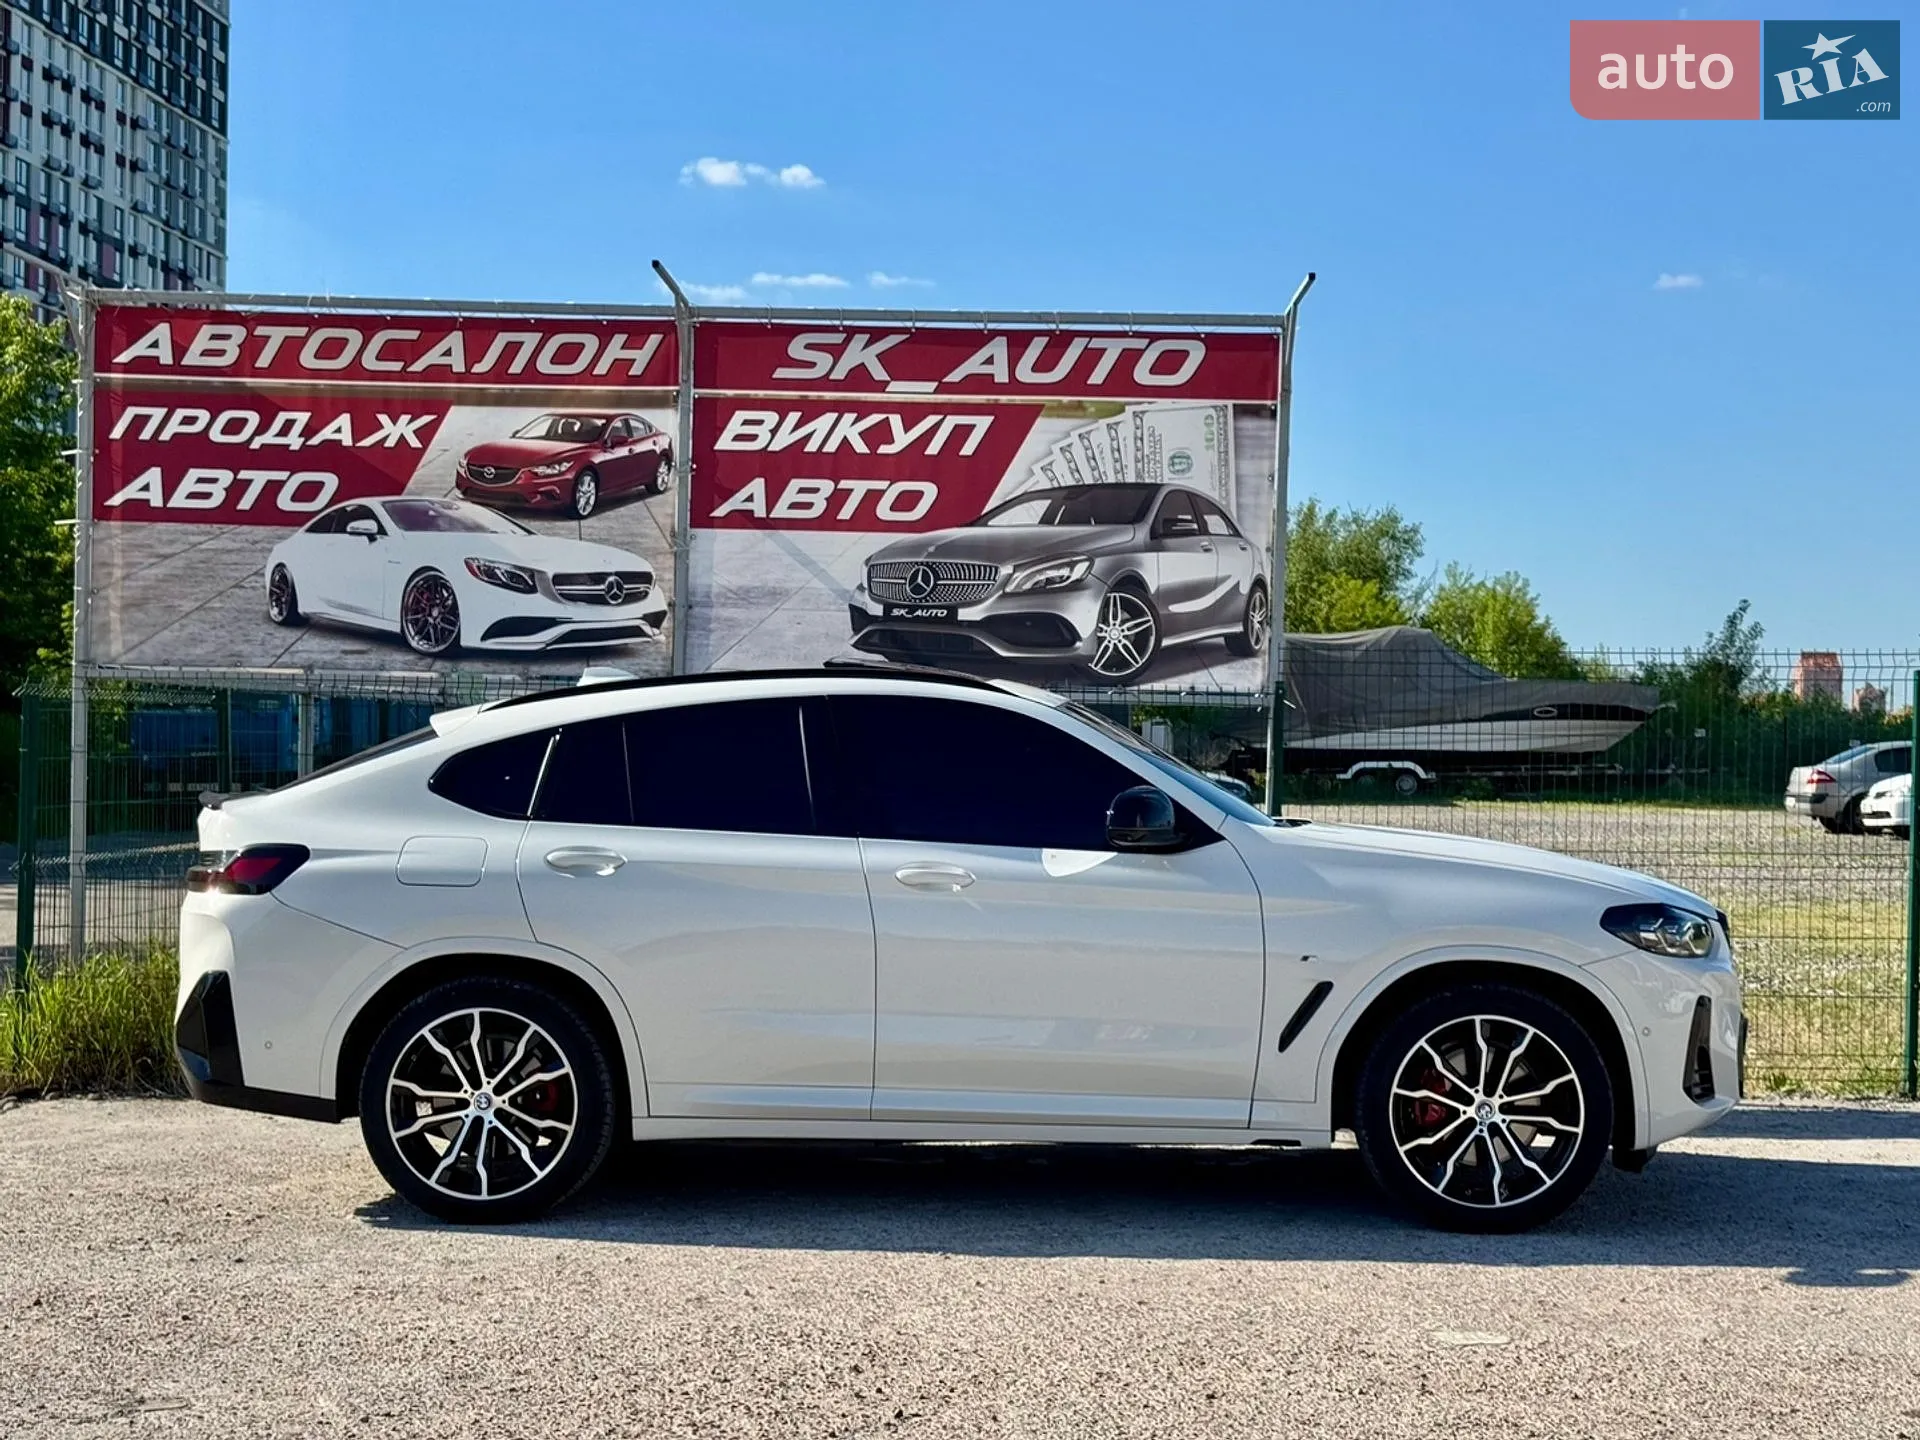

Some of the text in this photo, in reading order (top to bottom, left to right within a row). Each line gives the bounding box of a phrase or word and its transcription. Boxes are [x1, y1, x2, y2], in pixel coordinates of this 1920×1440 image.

[112, 322, 663, 377] АВТОСАЛОН
[772, 333, 1206, 393] SK_AUTO
[109, 406, 437, 450] ПРОДАЖ
[713, 410, 995, 456] ВИКУП
[104, 467, 339, 512] АВТО
[709, 478, 939, 522] АВТО
[890, 607, 948, 618] SK_AUTO
